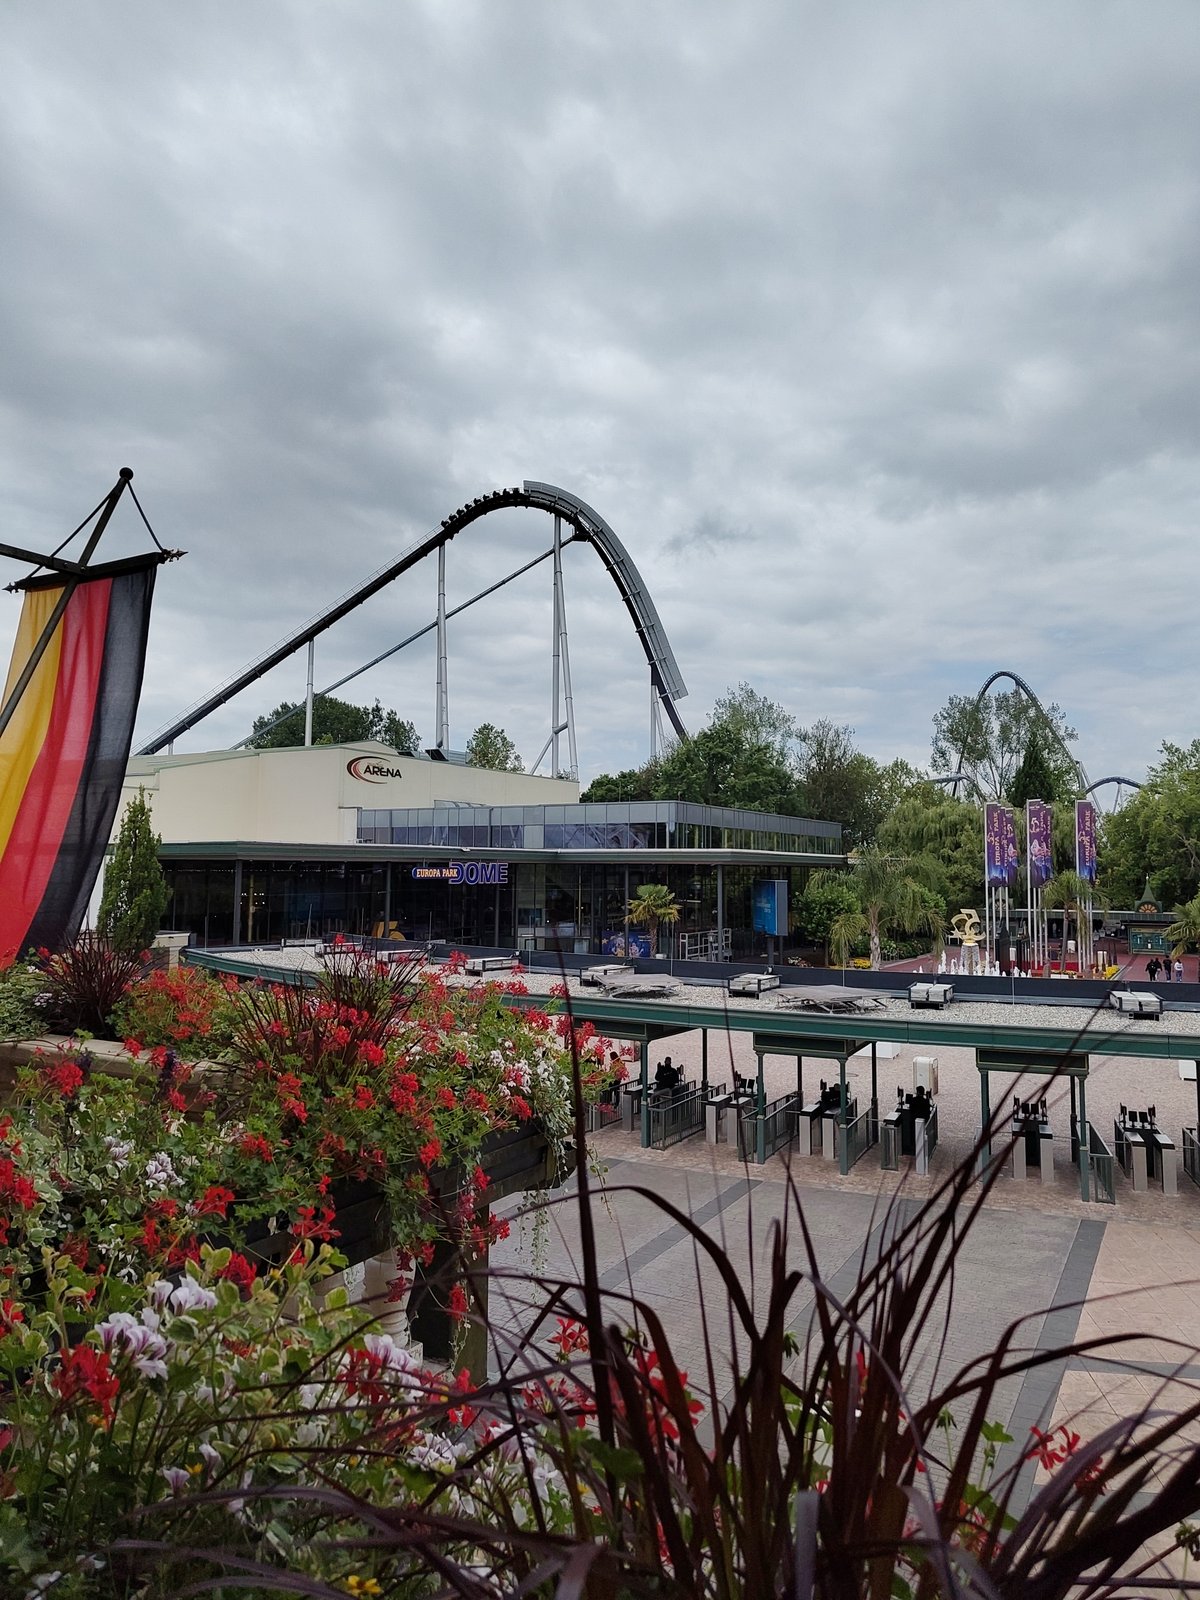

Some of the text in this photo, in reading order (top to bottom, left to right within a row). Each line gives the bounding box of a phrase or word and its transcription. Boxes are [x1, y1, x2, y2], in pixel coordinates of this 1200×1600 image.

[363, 765, 402, 779] ARENA
[416, 861, 508, 885] EUROPA PARK DOME
